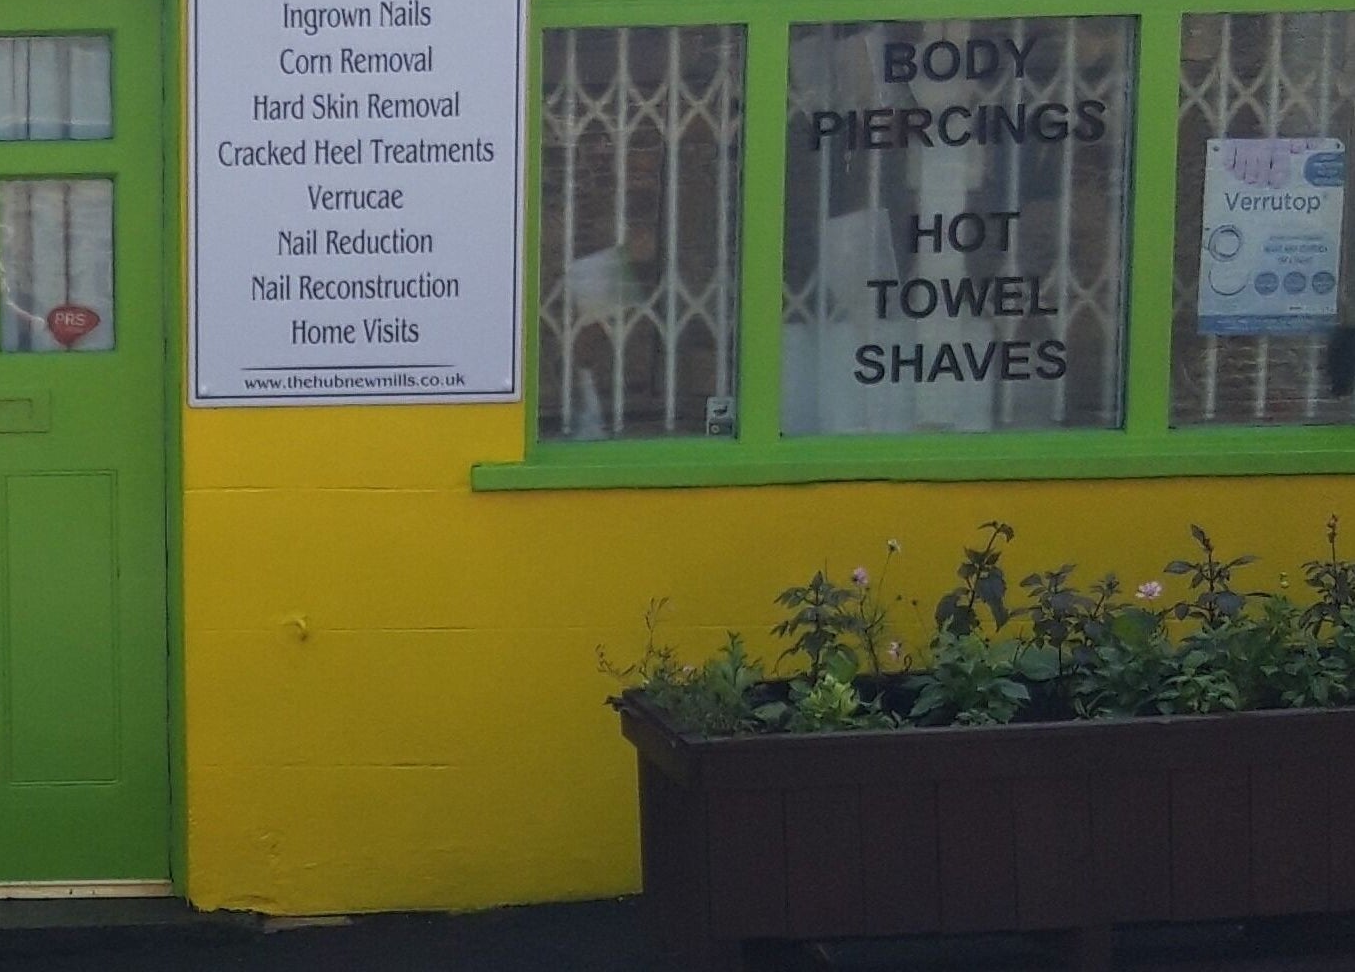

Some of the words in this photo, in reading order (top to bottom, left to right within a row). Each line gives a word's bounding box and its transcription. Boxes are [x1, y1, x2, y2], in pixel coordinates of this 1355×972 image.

[284, 4, 370, 35] Ingrown
[380, 0, 431, 26] Nails
[280, 49, 331, 74] Corn
[341, 46, 432, 73] Removal
[884, 39, 1038, 83] BODY
[254, 94, 304, 120] Hard
[313, 93, 358, 119] Skin
[368, 91, 459, 118] Removal
[811, 101, 1106, 151] PIERCINGS
[219, 140, 305, 166] Cracked
[315, 139, 361, 164] Heel
[370, 138, 494, 163] Treatments
[308, 185, 403, 210] Verrucae
[1225, 193, 1321, 213] Verrutop
[279, 230, 317, 255] Nail
[327, 228, 432, 254] Reduction
[909, 211, 1020, 254] HOT
[252, 275, 290, 300] Nail
[300, 272, 458, 300] Reconstruction
[867, 278, 1058, 319] TOWEL
[55, 312, 85, 326] PRS
[293, 320, 355, 344] Home
[364, 318, 419, 343] Visits
[854, 342, 1067, 385] SHAVES
[244, 374, 464, 390] www.thehubnewmills.co.uk
